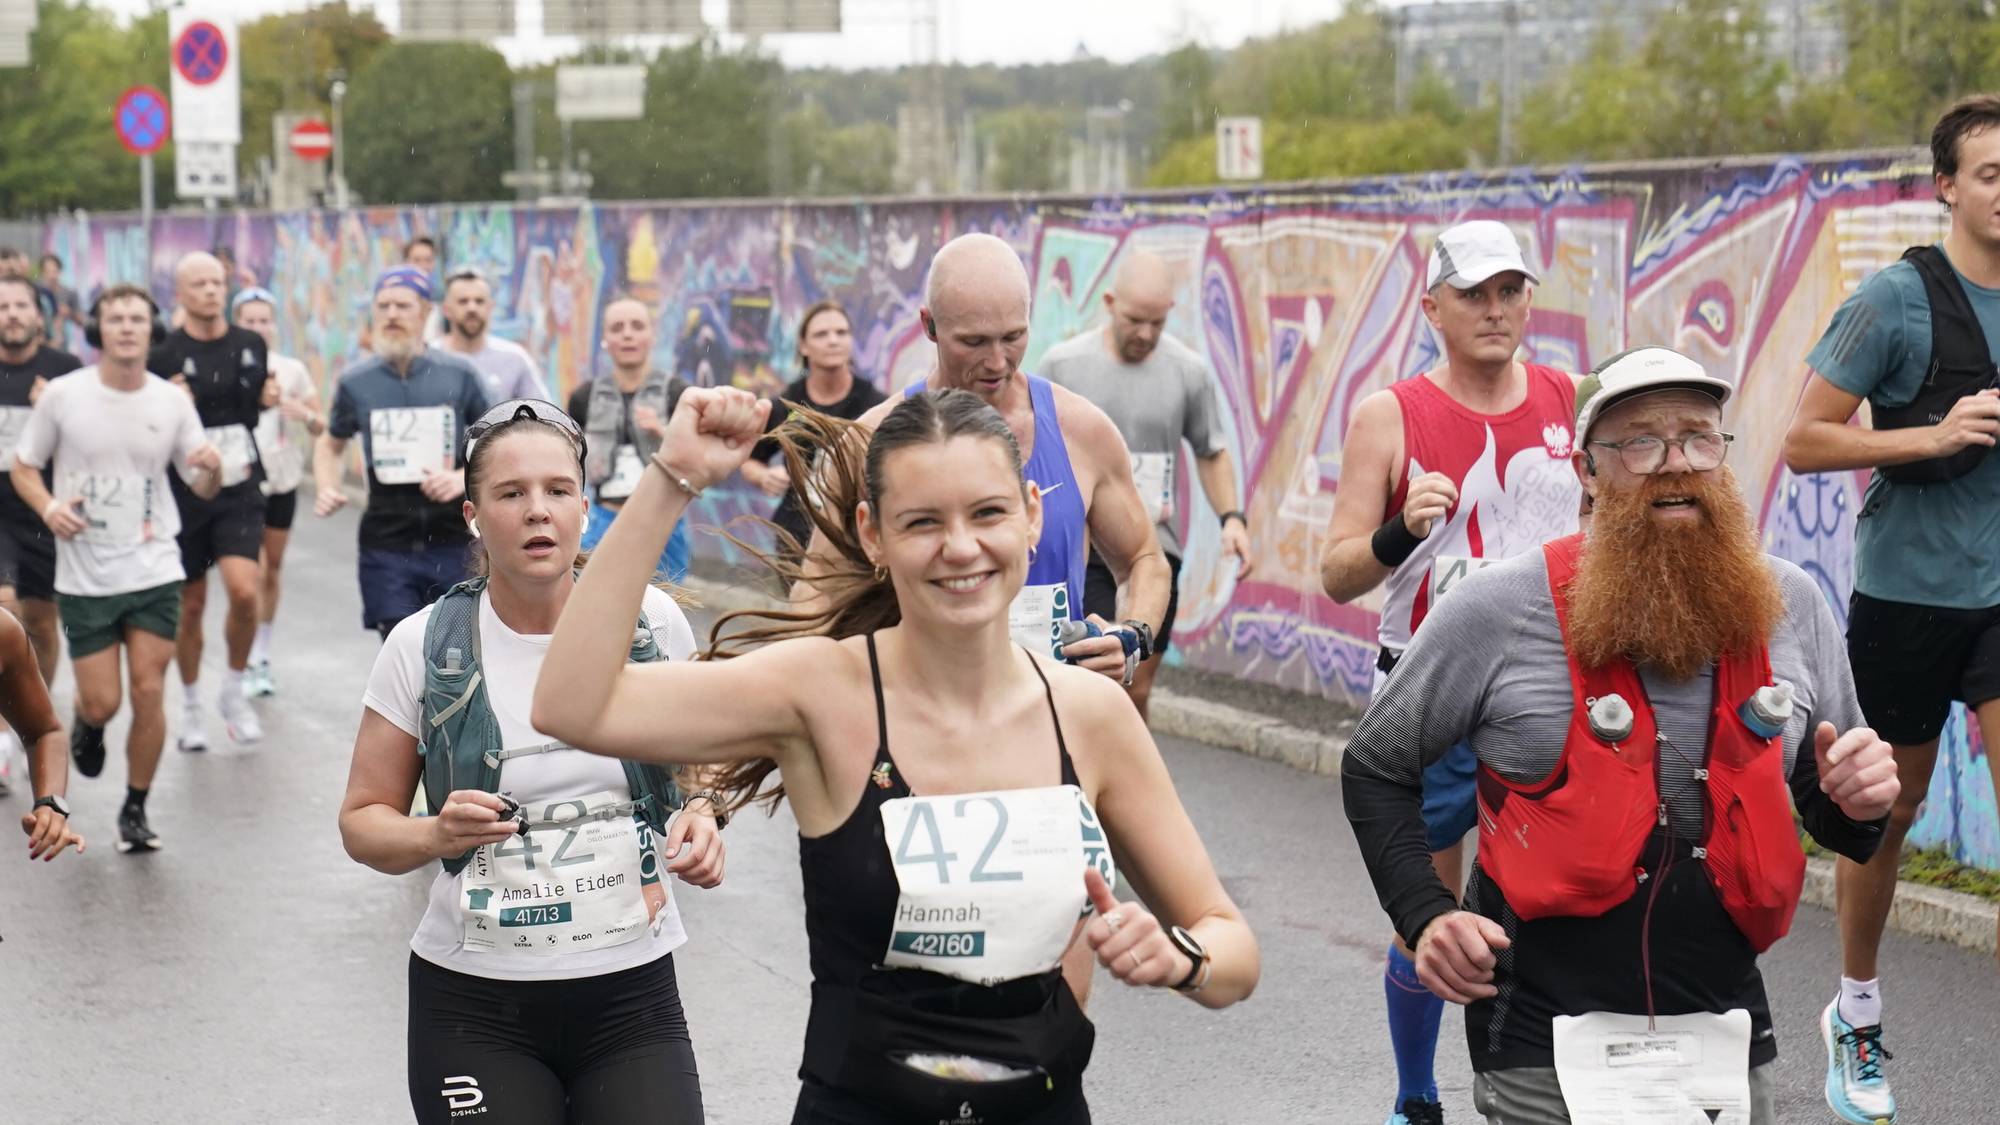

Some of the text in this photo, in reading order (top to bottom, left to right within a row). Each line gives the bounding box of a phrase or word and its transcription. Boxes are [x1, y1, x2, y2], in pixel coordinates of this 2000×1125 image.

[373, 409, 419, 443] 42
[79, 475, 123, 507] 42
[494, 799, 595, 871] 42
[894, 797, 1024, 884] 42
[501, 873, 625, 902] Amalie Eidem
[514, 906, 559, 924] 41713
[898, 901, 980, 922] Hannah
[909, 934, 974, 955] 42160
